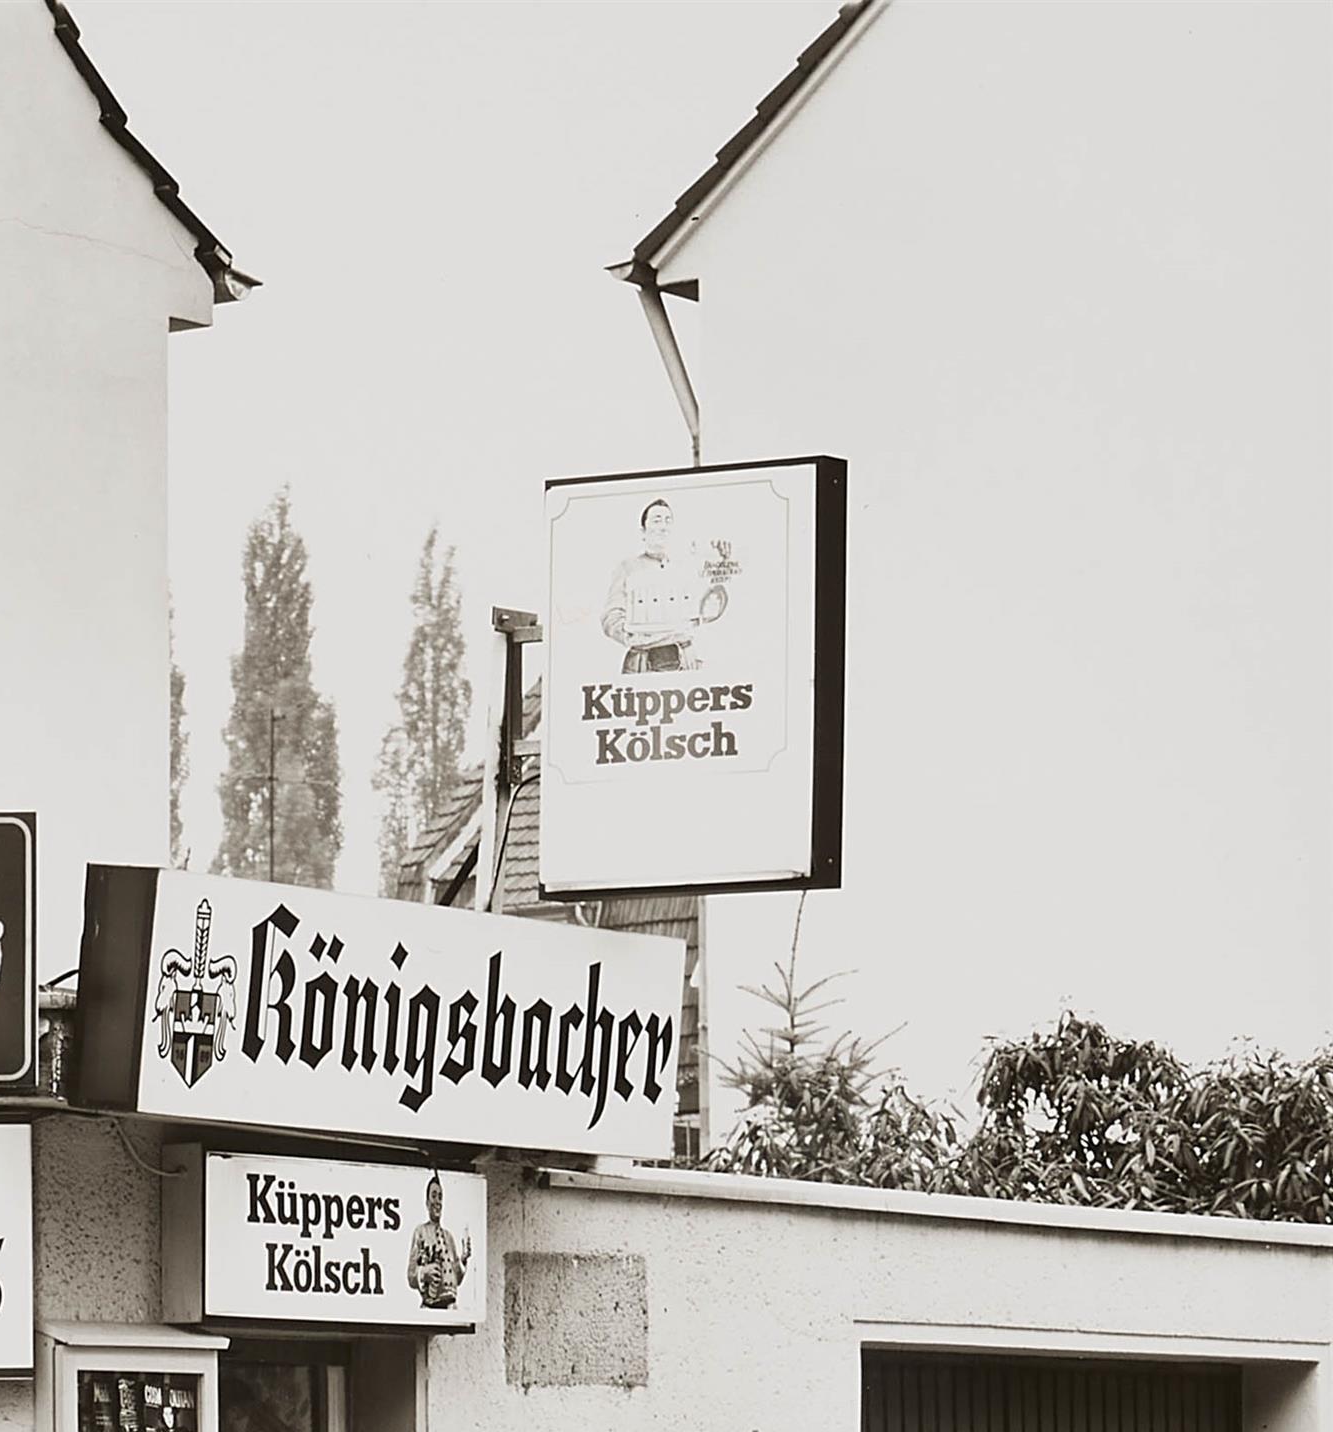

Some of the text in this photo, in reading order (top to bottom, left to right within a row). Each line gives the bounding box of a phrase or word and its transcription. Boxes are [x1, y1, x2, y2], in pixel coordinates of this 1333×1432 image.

[580, 680, 754, 727] Küppers
[595, 721, 740, 766] Kölsch
[241, 902, 675, 1130] Königsbacher
[245, 1172, 402, 1239] Küppers
[264, 1241, 385, 1297] Kölsch
